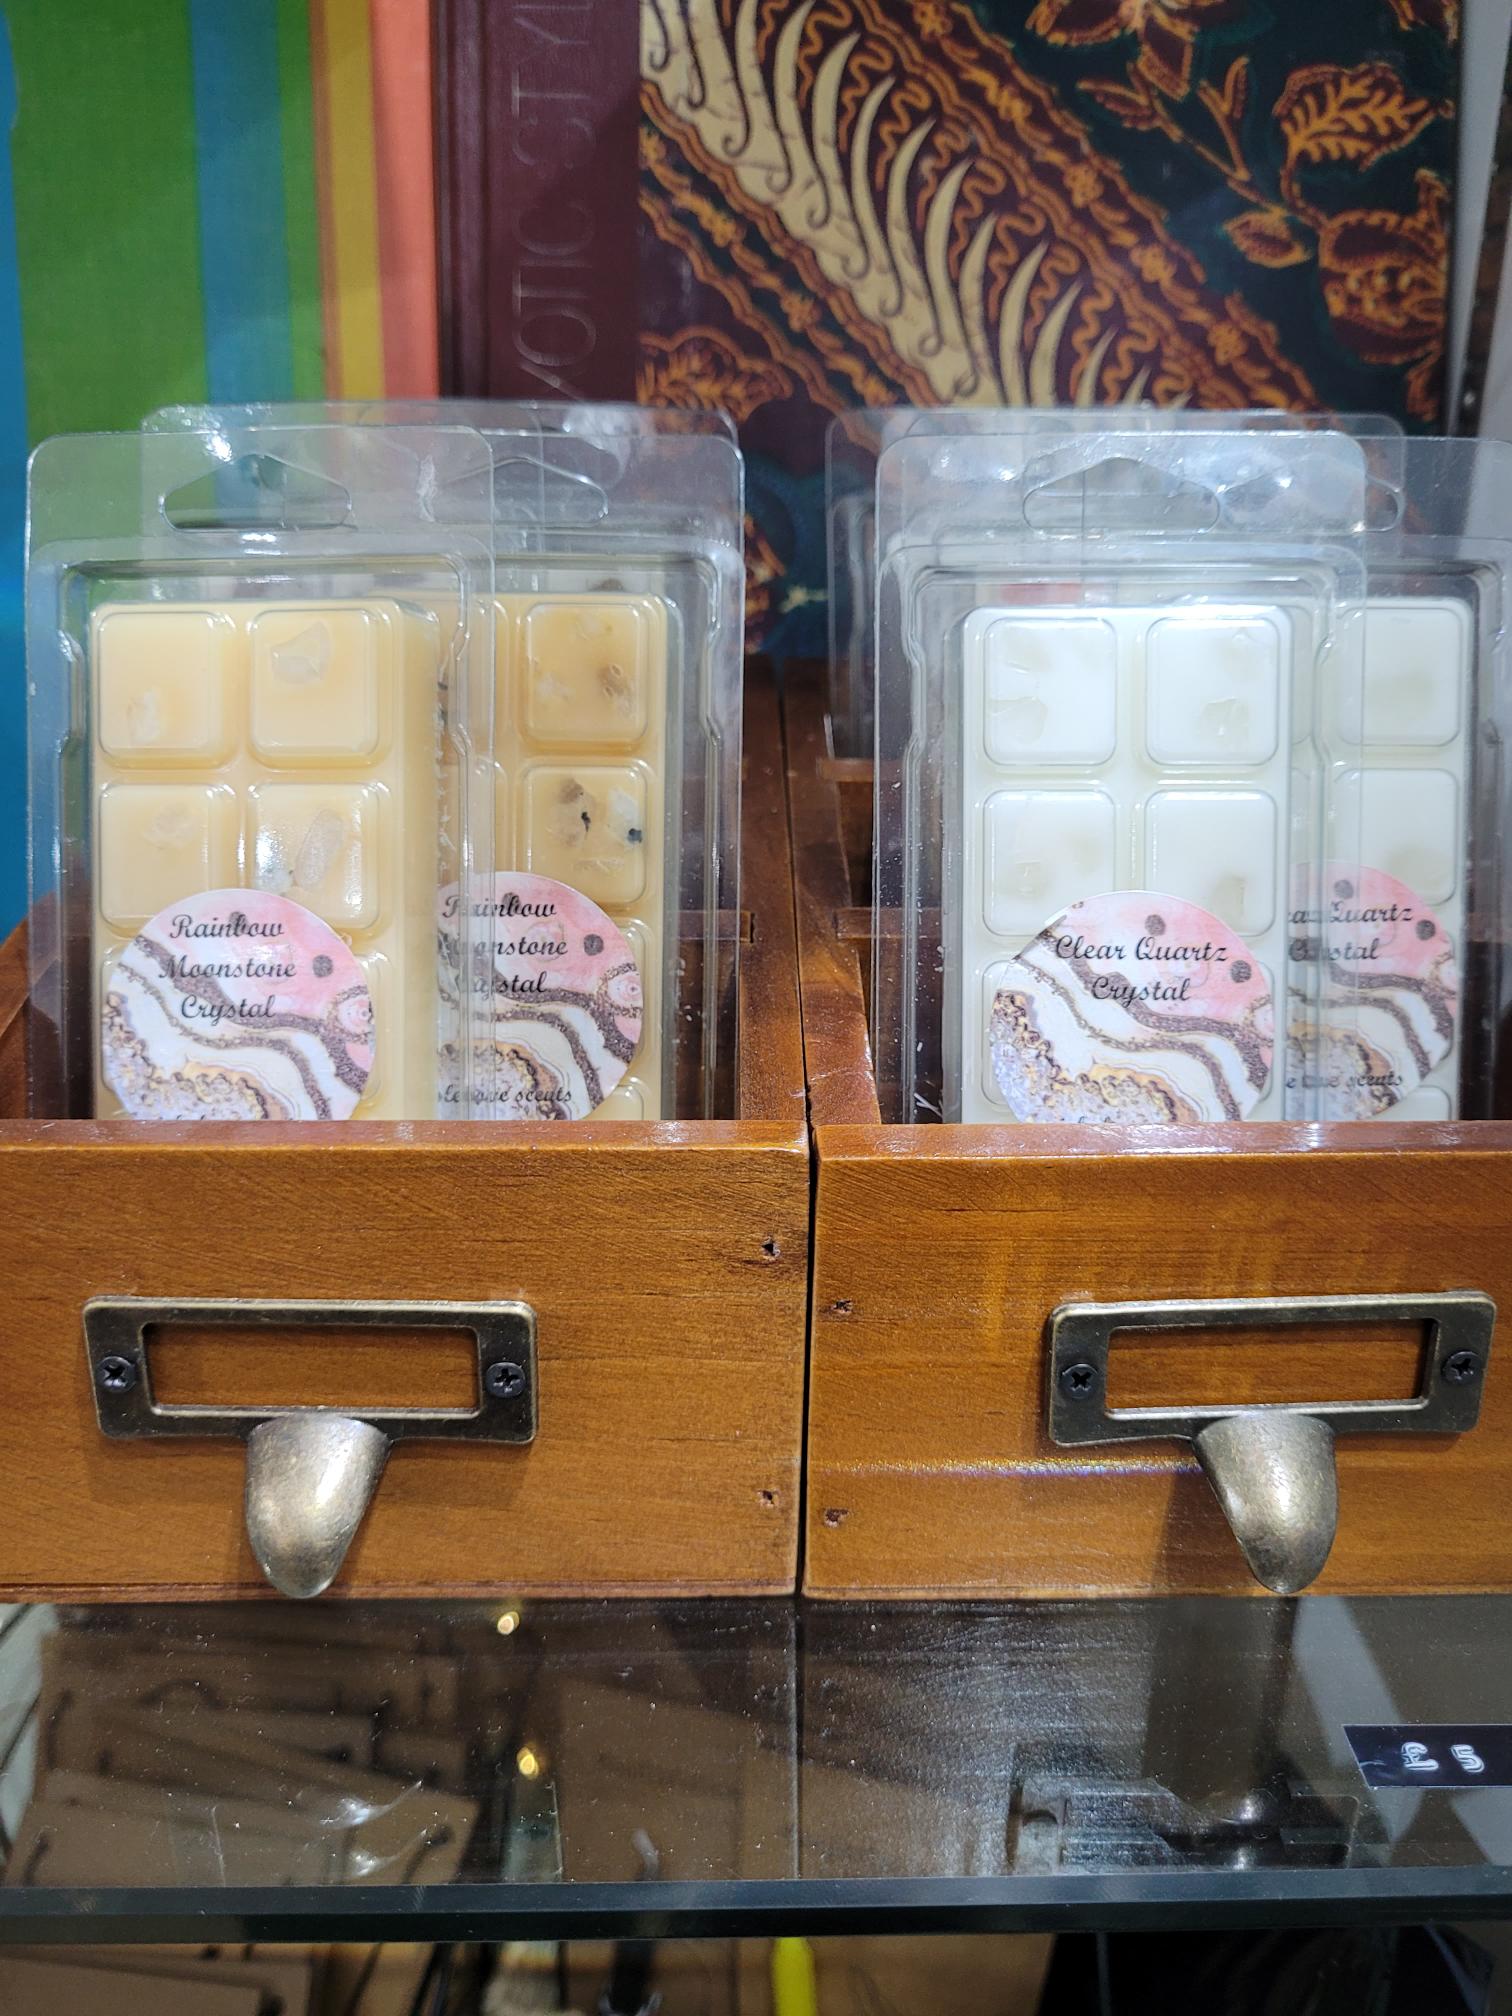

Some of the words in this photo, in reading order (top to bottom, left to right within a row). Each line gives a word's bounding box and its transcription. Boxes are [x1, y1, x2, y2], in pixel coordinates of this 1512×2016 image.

[169, 912, 284, 938] Rainbow
[1055, 934, 1125, 960] Clear
[1136, 935, 1228, 962] Quartz
[159, 955, 297, 978] Moonstone
[1092, 976, 1190, 1007] Crystal
[181, 994, 276, 1026] Crystal
